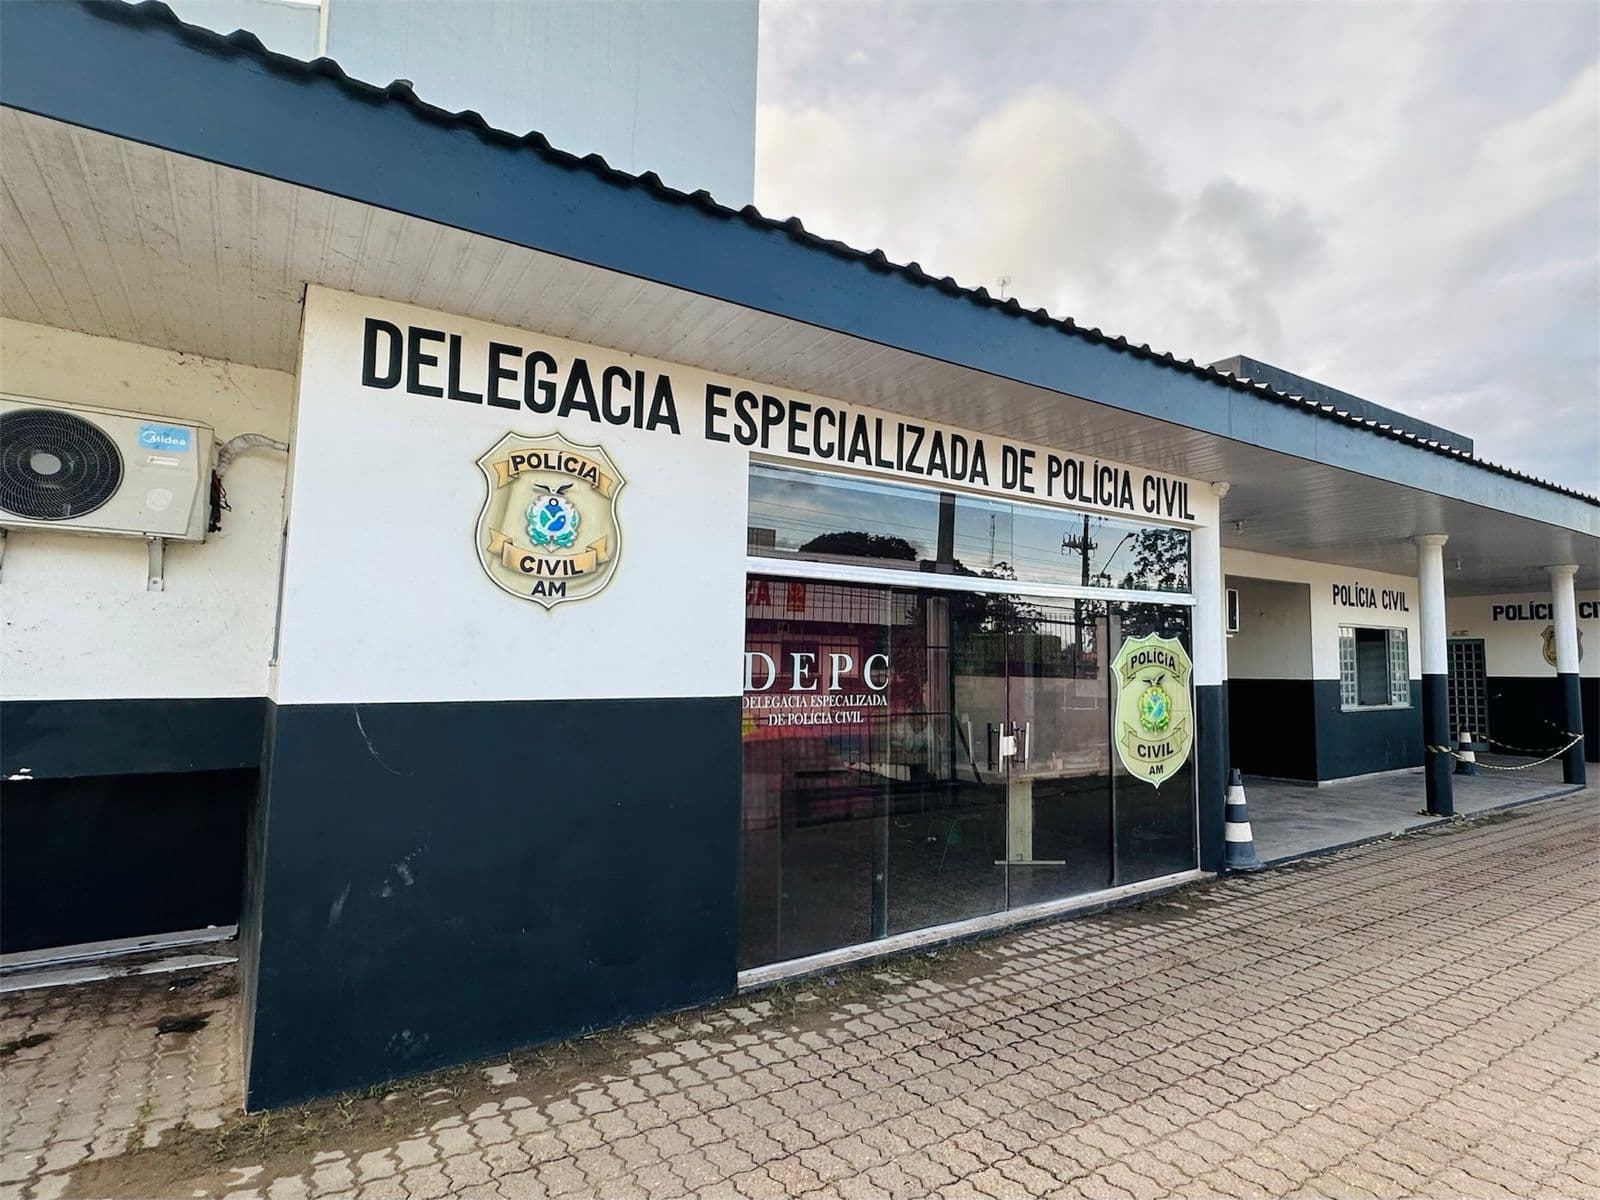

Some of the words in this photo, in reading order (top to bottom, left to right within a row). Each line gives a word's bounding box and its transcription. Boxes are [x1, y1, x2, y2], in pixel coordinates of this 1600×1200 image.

[362, 317, 681, 435] DELEGACIA
[705, 384, 989, 486] ESPECIALIZADA
[1002, 445, 1036, 493] DE
[1047, 459, 1134, 510] POLÍCIA
[1143, 475, 1195, 520] CIVIL
[143, 430, 186, 446] Midea
[511, 452, 599, 483] POLÍCIA
[519, 556, 583, 576] CIVIL
[531, 581, 566, 597] AM
[1332, 581, 1377, 608] POLÍCIA
[1382, 589, 1409, 612] CIVIL
[1492, 601, 1554, 621] POLÍCI
[1579, 602, 1600, 618] CI
[1130, 648, 1176, 669] POLÍCIA
[768, 713, 786, 726] DE
[788, 710, 833, 724] POLÍCIA
[835, 711, 864, 724] CIVIL
[1137, 742, 1174, 758] CIVIL
[1149, 765, 1164, 775] AM
